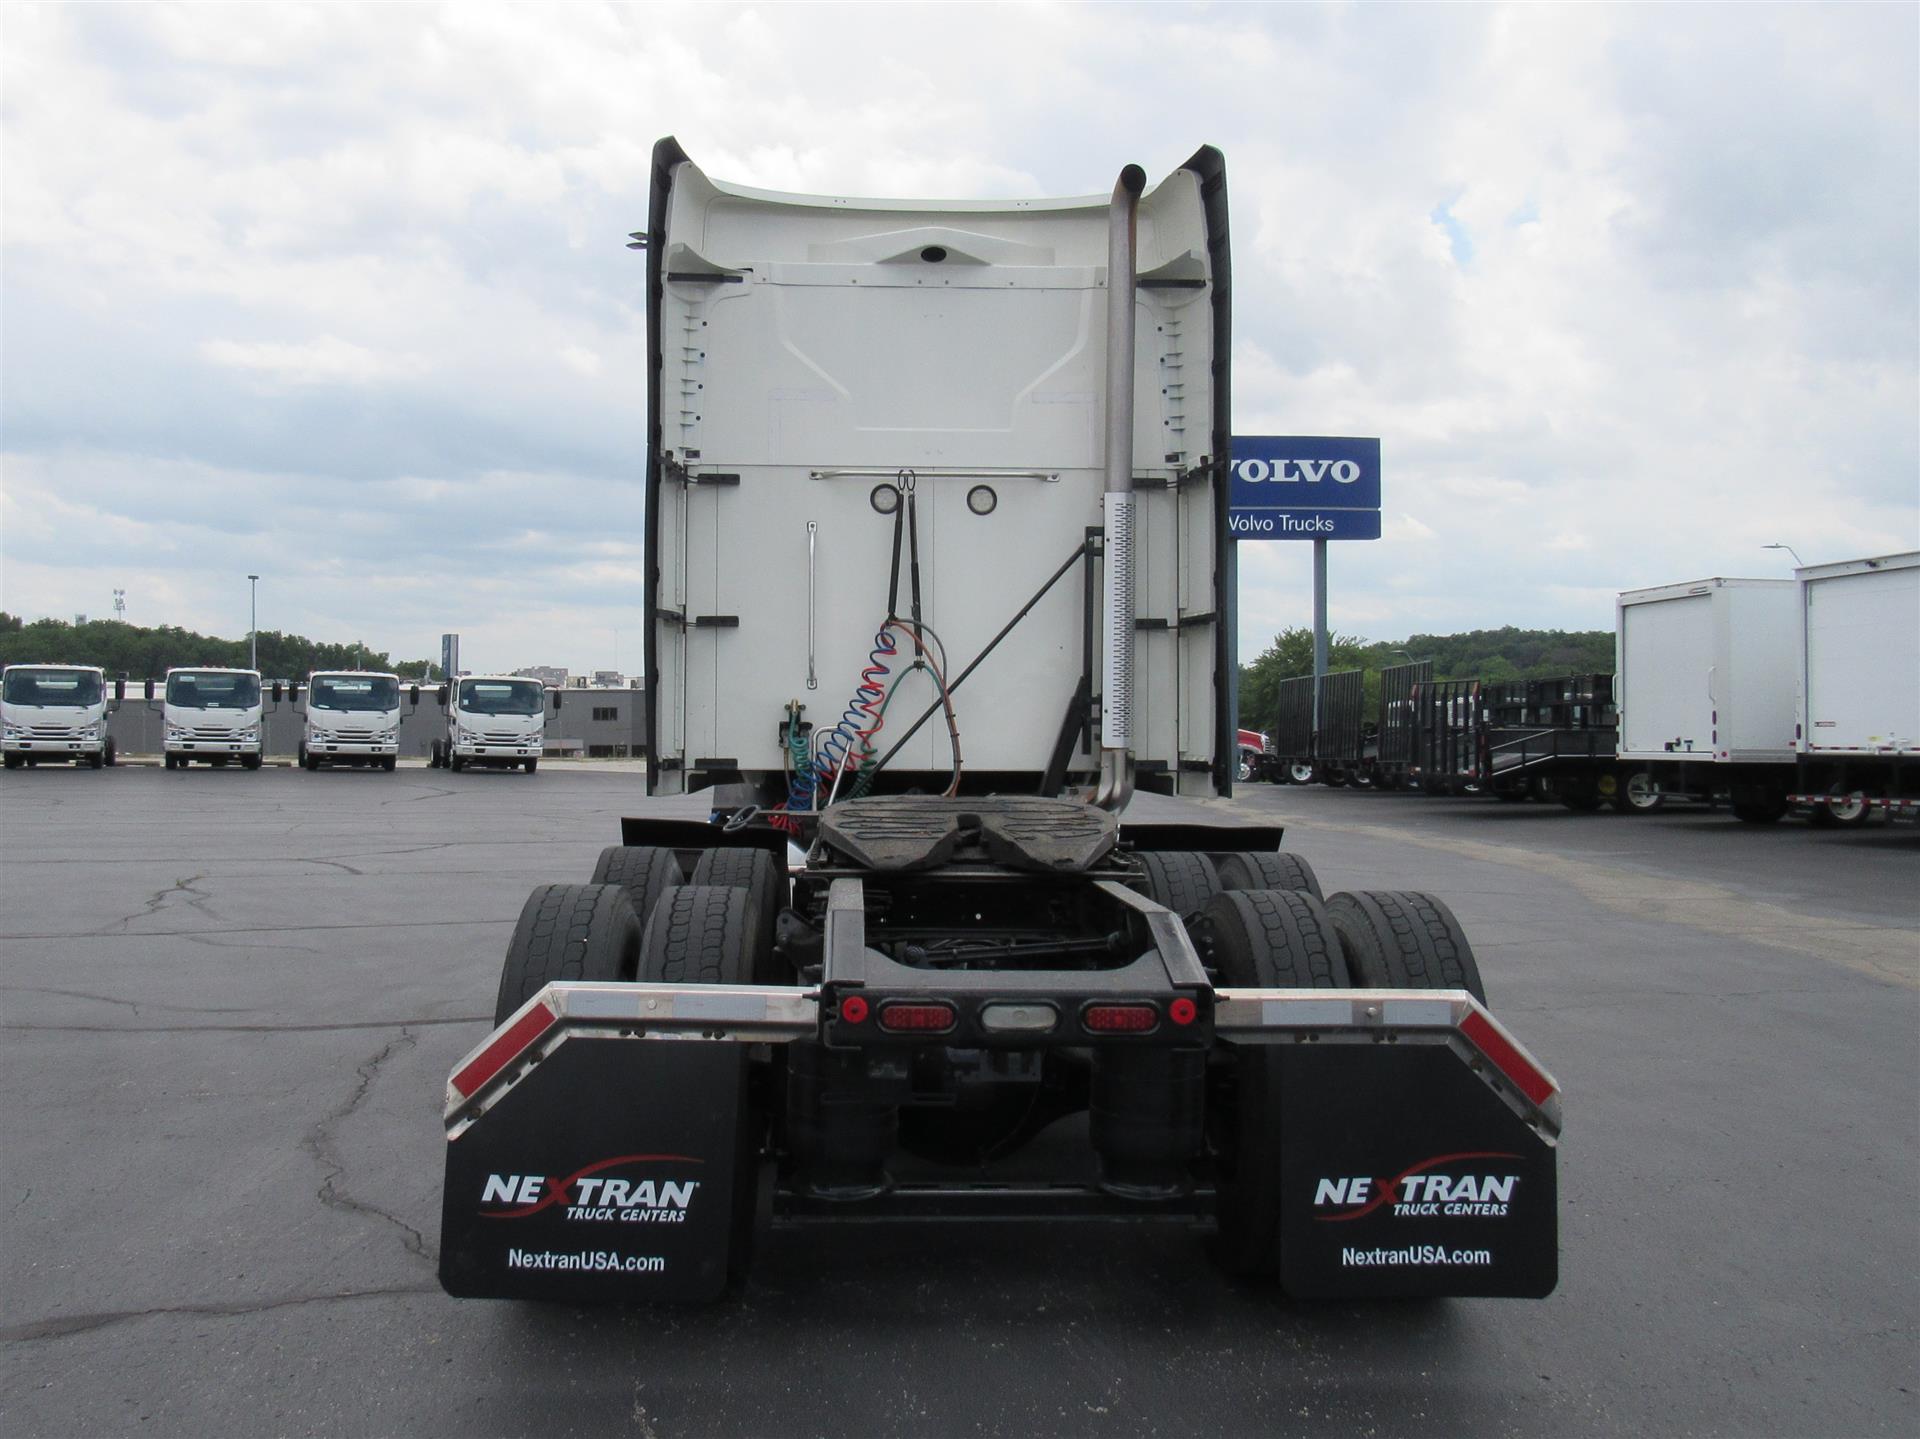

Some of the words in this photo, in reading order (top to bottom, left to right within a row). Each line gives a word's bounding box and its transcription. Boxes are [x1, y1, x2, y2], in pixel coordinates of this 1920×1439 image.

[1231, 459, 1360, 483] OLVO
[1229, 514, 1274, 532] Volvo
[1279, 514, 1335, 532] Trucks
[481, 1174, 698, 1209] NEXTRAN
[1314, 1175, 1516, 1205] NEXTRAN
[566, 1207, 614, 1221] TRUCK
[620, 1208, 687, 1222] CENTERS
[1394, 1203, 1439, 1217] TRUCK
[1444, 1203, 1508, 1216] CENTERS
[508, 1248, 665, 1272] NextranUSA.com
[1342, 1246, 1491, 1266] NextranUSA.com
